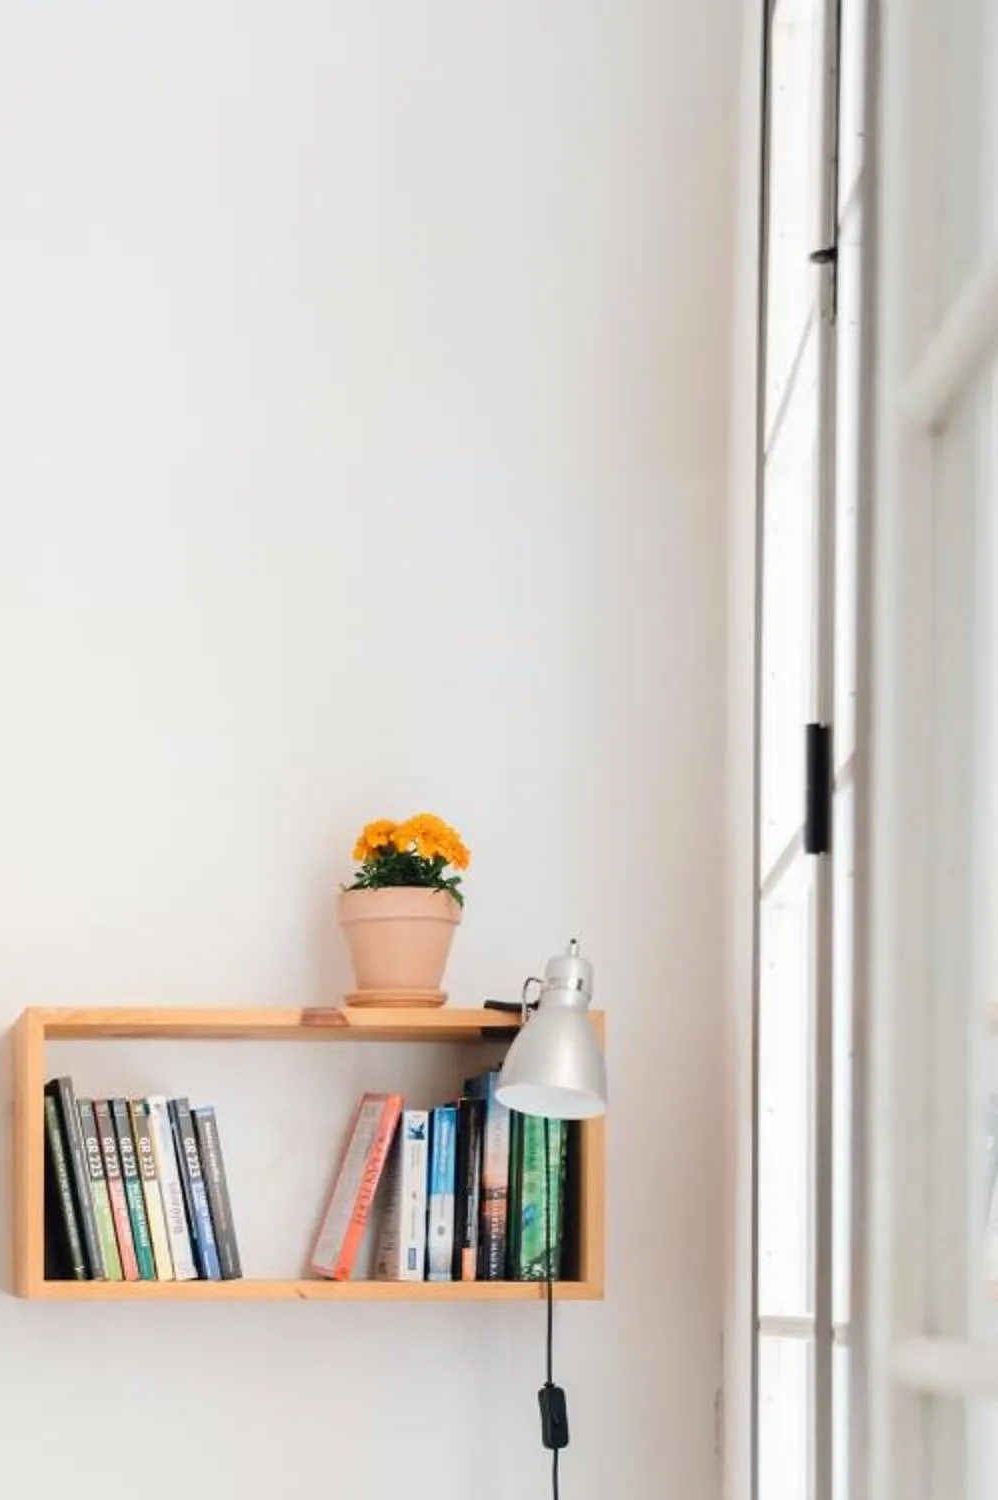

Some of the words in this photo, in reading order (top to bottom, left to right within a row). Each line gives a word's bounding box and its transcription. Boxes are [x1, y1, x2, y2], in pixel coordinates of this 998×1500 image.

[87, 1137, 97, 1152] GR
[102, 1137, 114, 1153] GR
[120, 1137, 132, 1154] GR
[140, 1138, 151, 1155] GR
[184, 1138, 196, 1155] GR
